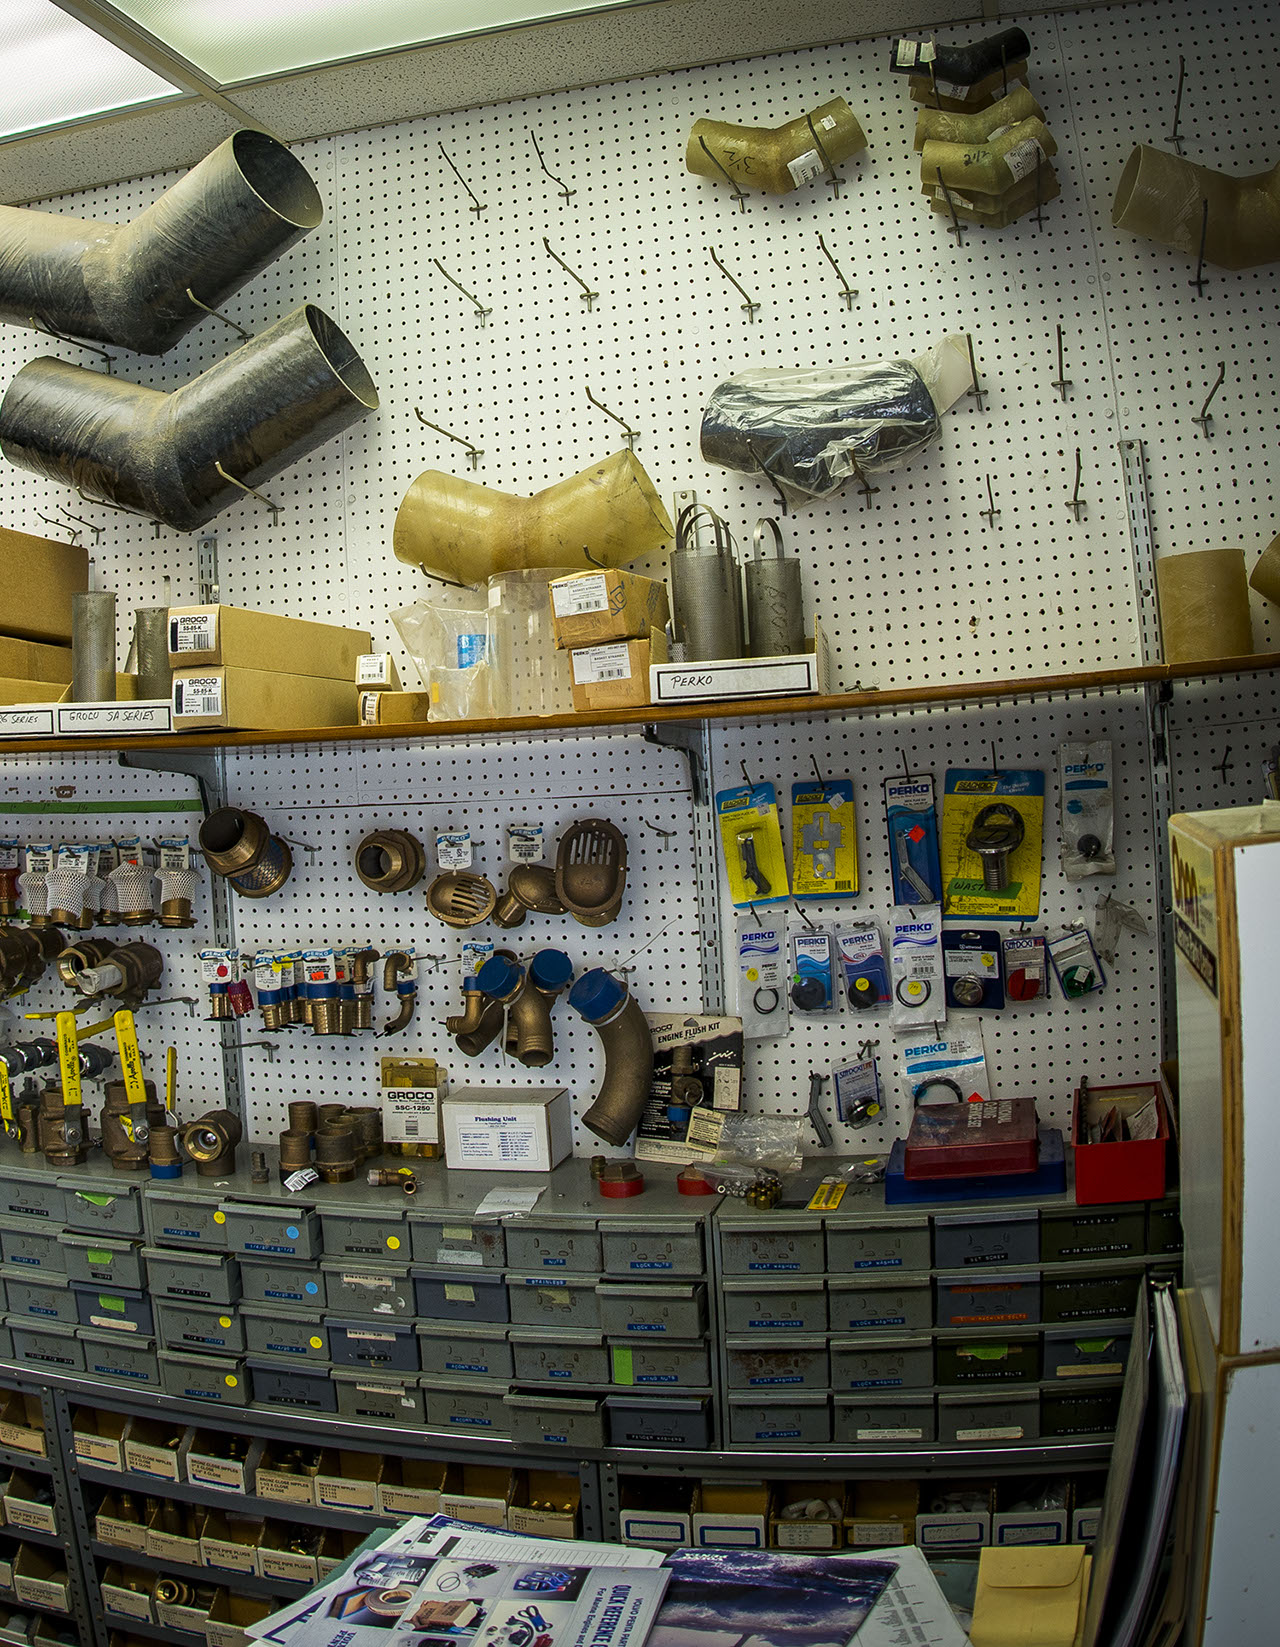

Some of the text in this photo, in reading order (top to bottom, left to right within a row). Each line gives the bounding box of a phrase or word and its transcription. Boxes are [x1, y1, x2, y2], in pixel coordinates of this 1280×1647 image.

[179, 616, 208, 624] GROCO
[671, 675, 713, 688] PERKO
[11, 713, 39, 724] SERIES
[69, 708, 155, 722] GROCO SA SERIES
[1065, 763, 1105, 774] PERKO
[889, 783, 930, 796] PERKO
[956, 781, 996, 792] SEACHOICE
[953, 881, 985, 891] WAST
[895, 924, 932, 933] PERKO
[742, 931, 776, 942] PERKO
[798, 937, 826, 946] PERKO
[842, 934, 874, 946] PERKO
[649, 1024, 673, 1034] ROCO
[658, 1022, 720, 1043] ENGINE FLUSH KIT
[905, 1042, 948, 1057] PERKO
[387, 1091, 435, 1100] GROCO
[597, 1587, 606, 1596] For
[588, 1597, 604, 1613] Marine
[631, 1597, 644, 1615] VOLVO
[591, 1584, 632, 1642] QUICK REFERENCE
[623, 1616, 636, 1632] PENTA
